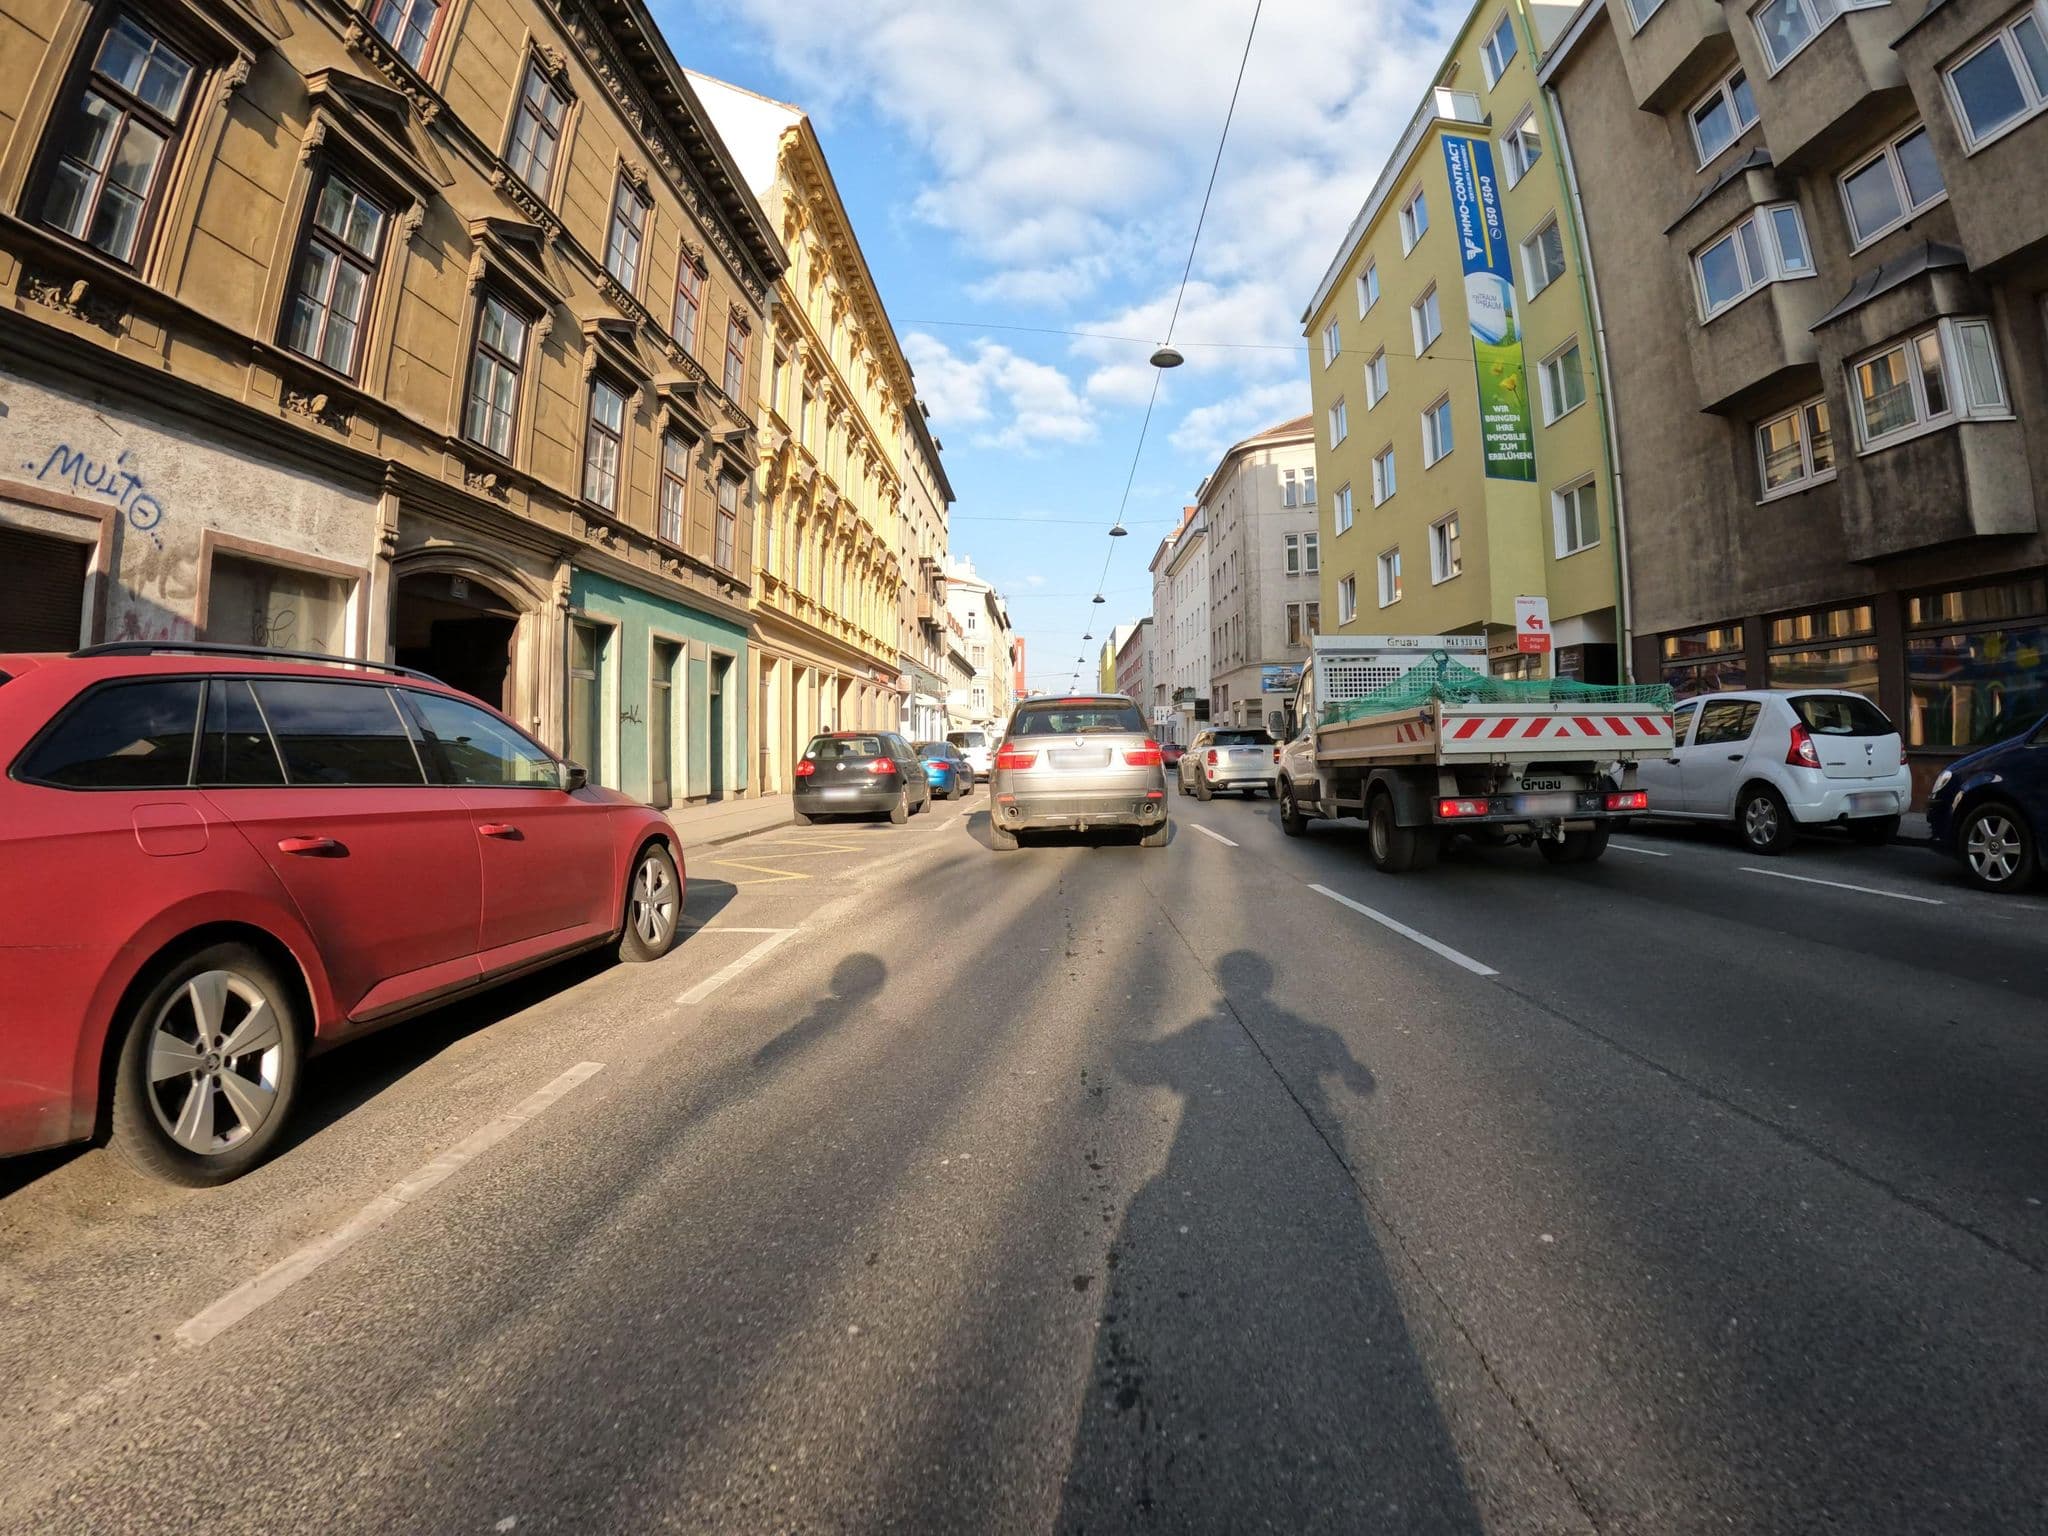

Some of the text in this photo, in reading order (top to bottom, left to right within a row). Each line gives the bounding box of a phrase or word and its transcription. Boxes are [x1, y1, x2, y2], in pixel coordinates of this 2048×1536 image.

[1447, 141, 1473, 237] IMMO-CONTRACT
[1480, 176, 1498, 226] 050 450-0
[1487, 433, 1527, 441] IMMOBILIE
[1488, 451, 1533, 460] ERBLÜHEN!
[1387, 638, 1419, 647] Gruau
[1521, 778, 1562, 791] Gruau
